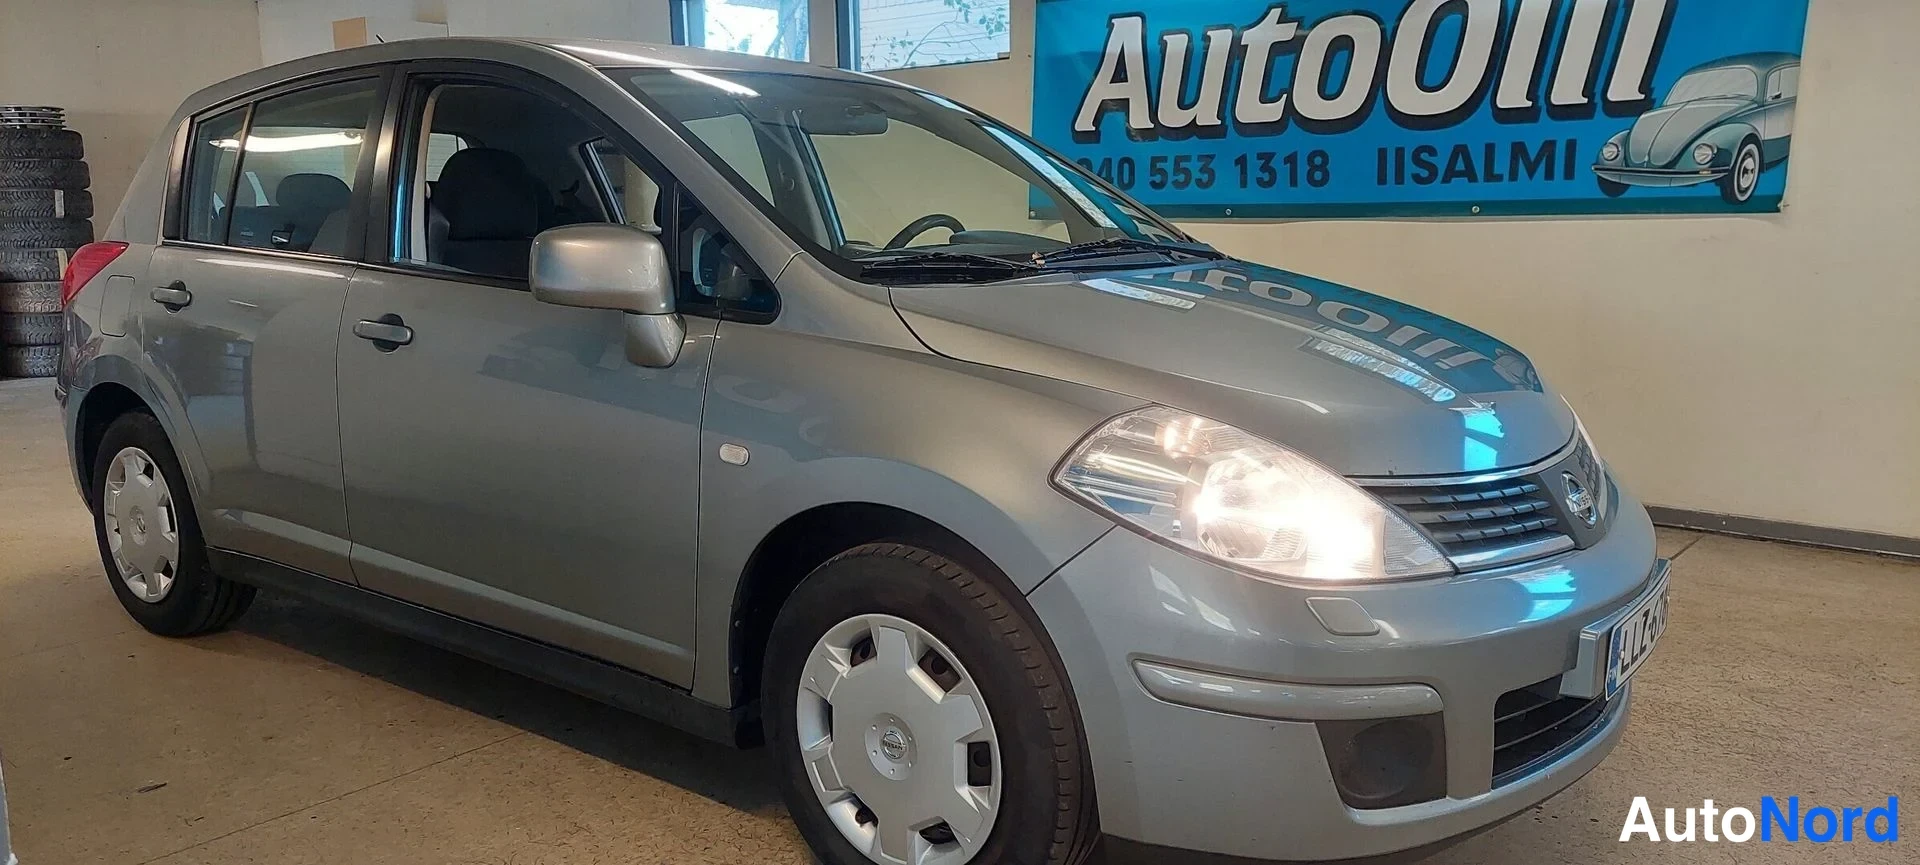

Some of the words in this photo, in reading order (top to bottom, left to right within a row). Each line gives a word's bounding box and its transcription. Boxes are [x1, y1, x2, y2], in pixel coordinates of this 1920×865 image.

[1149, 153, 1216, 190] 553
[1234, 149, 1330, 189] 1318
[1376, 139, 1577, 186] IISALMI
